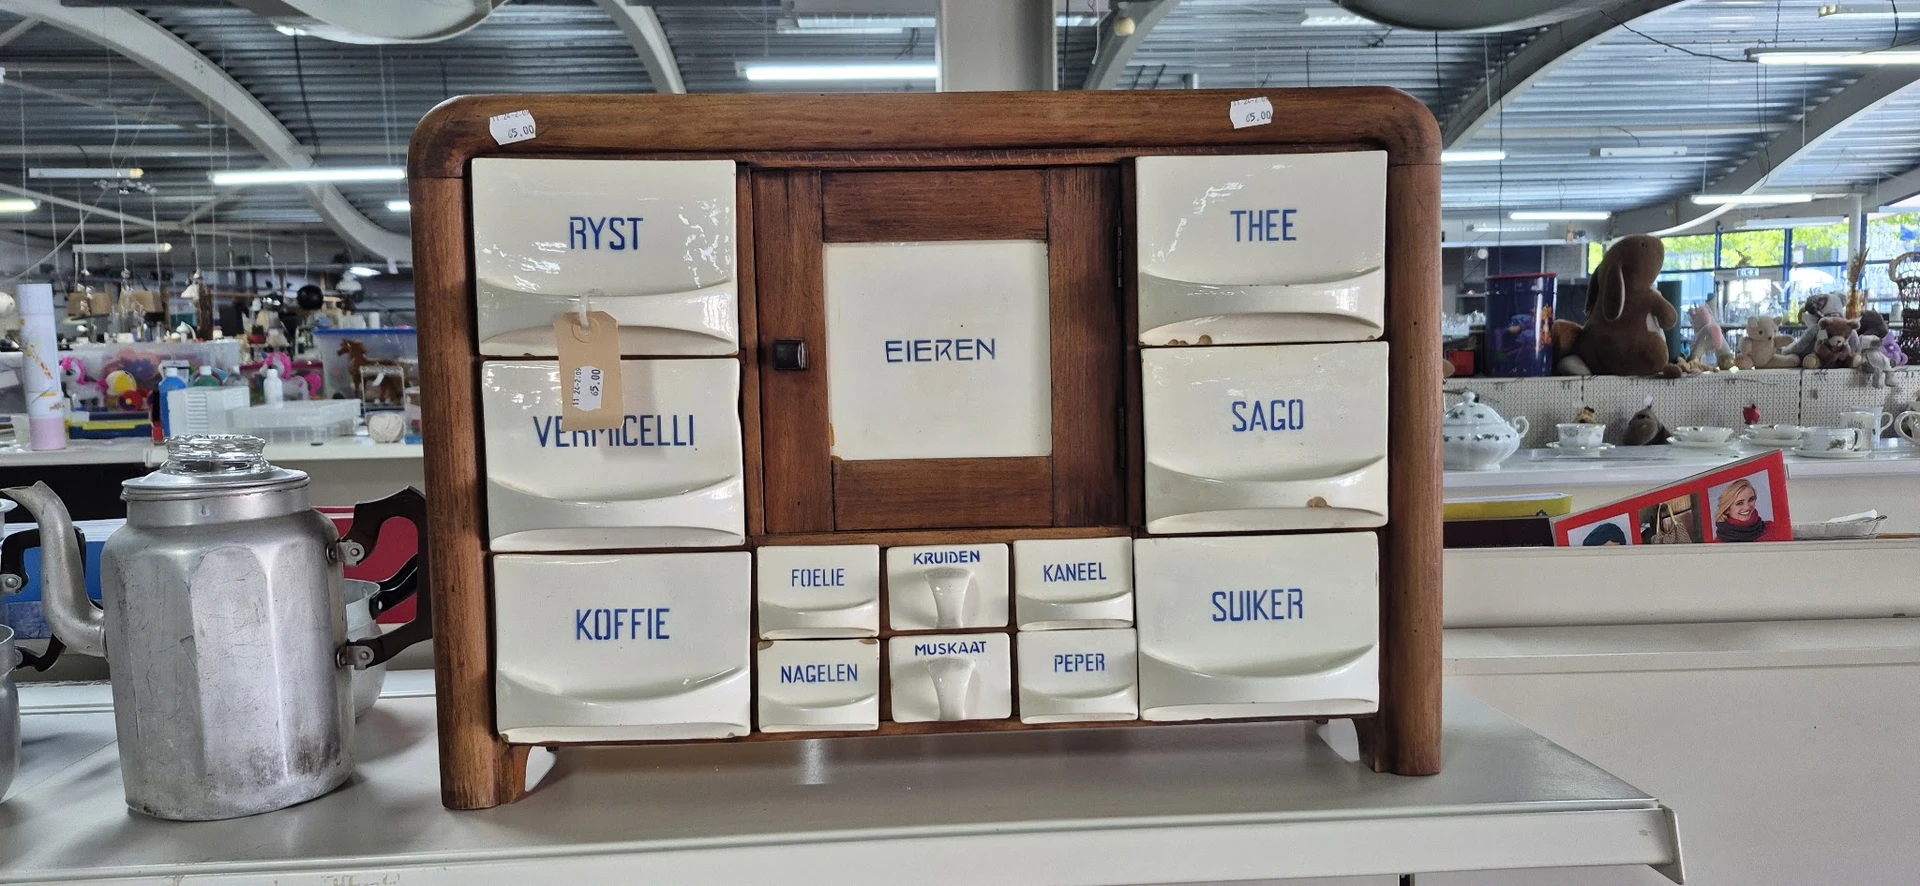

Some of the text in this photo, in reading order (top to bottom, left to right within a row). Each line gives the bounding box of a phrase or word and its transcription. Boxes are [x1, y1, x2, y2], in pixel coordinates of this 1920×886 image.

[1246, 110, 1271, 122] 65.00
[508, 124, 534, 138] 65.00
[569, 216, 643, 252] RYST
[1230, 209, 1298, 242] THEE
[885, 338, 996, 363] EIEREN
[590, 369, 601, 397] 65.00
[1231, 399, 1306, 434] SAGO
[913, 550, 981, 565] KRUIDEN
[791, 568, 845, 588] FOELIE
[1042, 562, 1107, 583] KANEEL
[1211, 588, 1305, 623] SUIKER
[575, 608, 670, 641] KOFFIE
[914, 641, 987, 656] MUSKAAT
[780, 663, 859, 684] NAGELEN
[1054, 653, 1106, 673] PEPER
